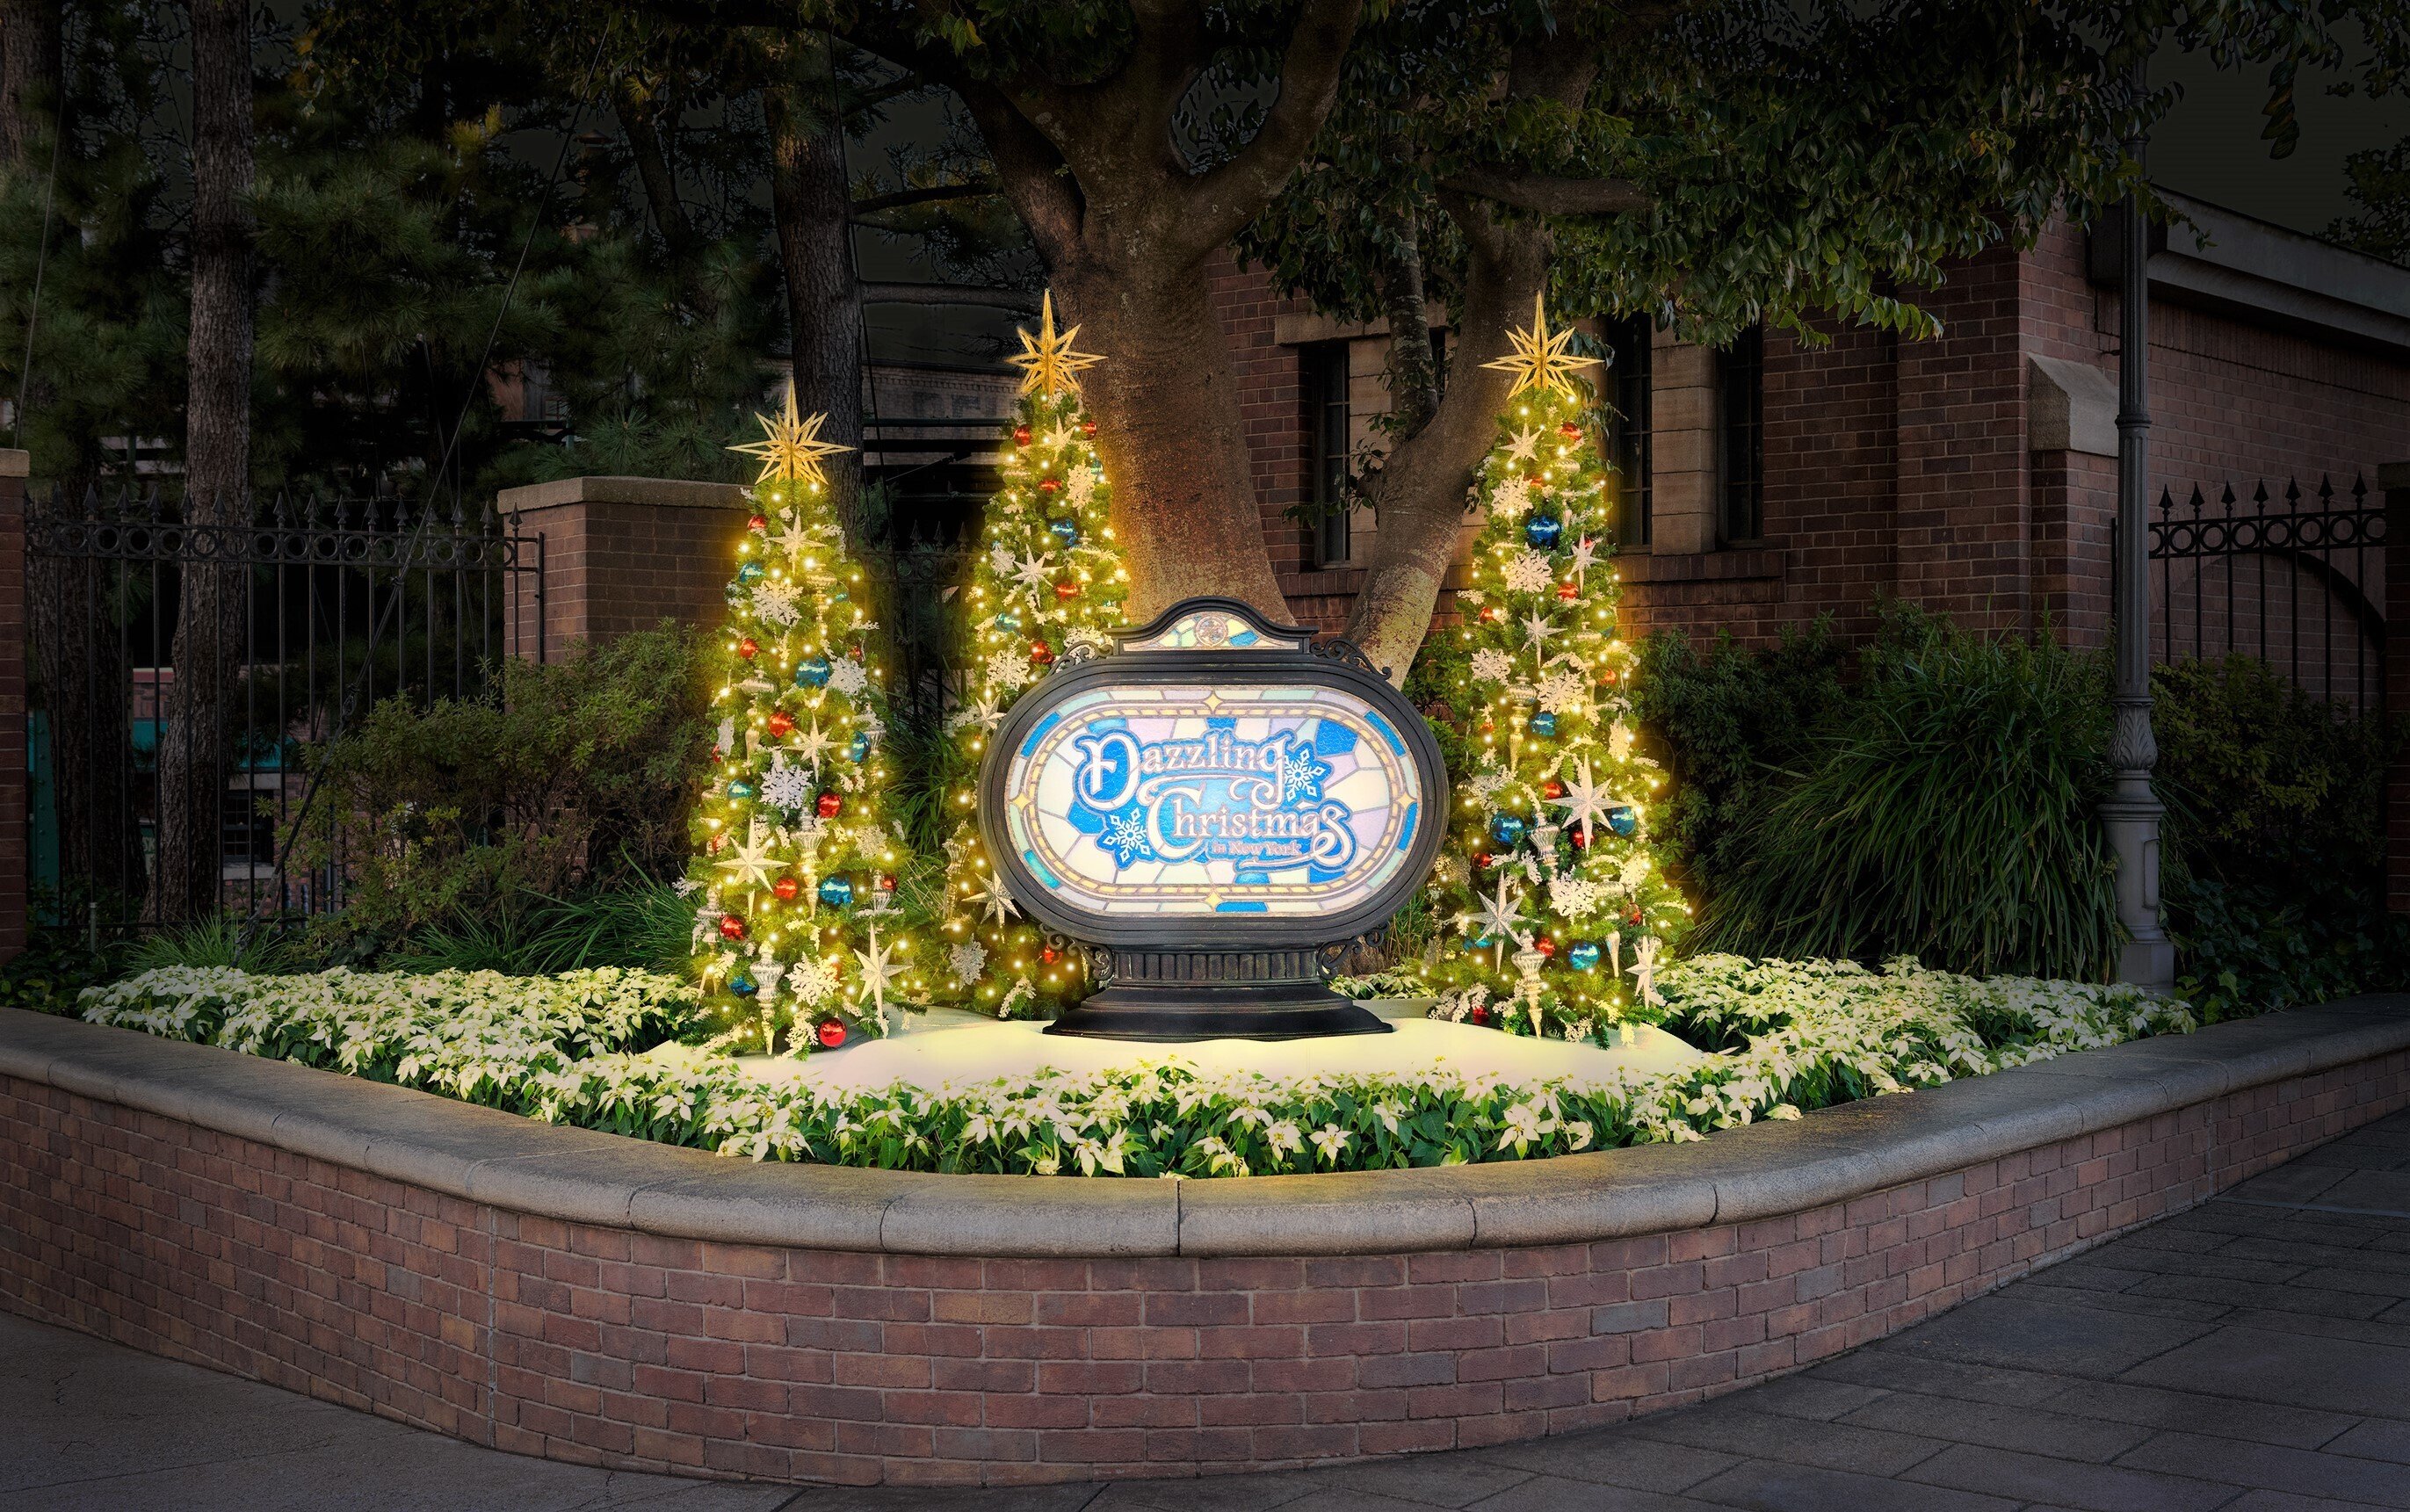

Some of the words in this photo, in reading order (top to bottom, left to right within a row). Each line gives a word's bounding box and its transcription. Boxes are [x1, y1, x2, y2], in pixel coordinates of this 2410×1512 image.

[1077, 732, 1295, 810] Dazzling
[1138, 777, 1352, 865] Christmas
[1212, 839, 1227, 854] in
[1228, 841, 1265, 855] New
[1264, 840, 1302, 856] York
